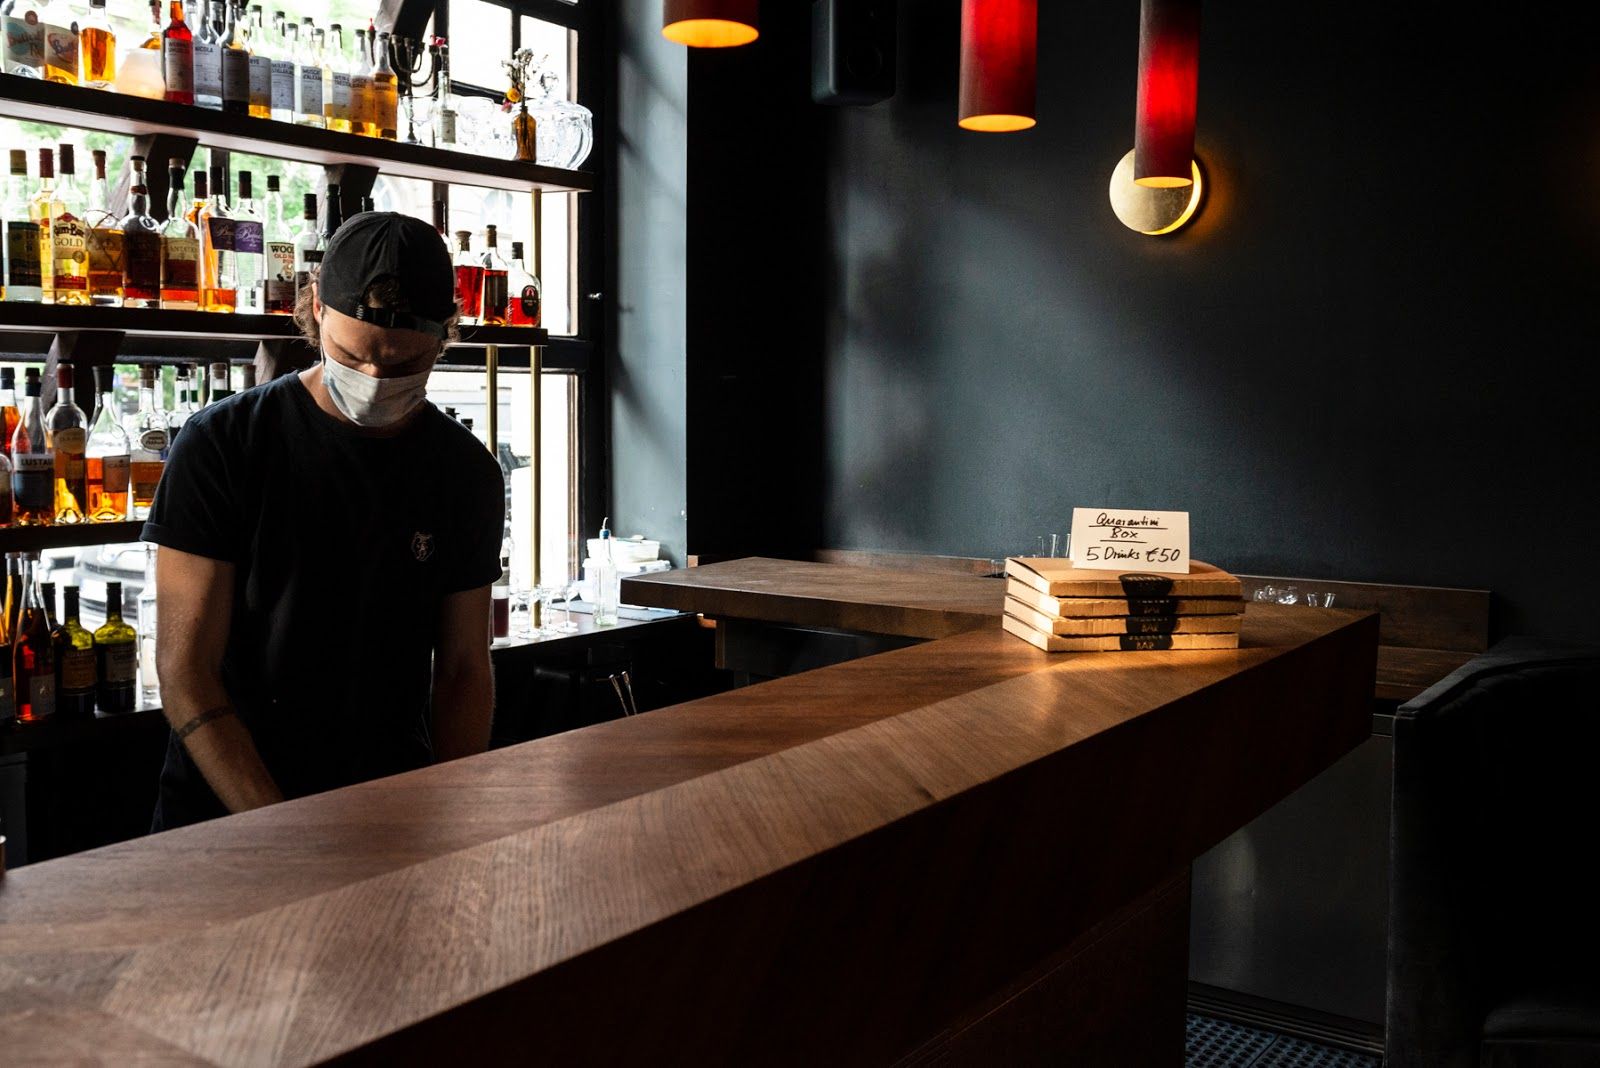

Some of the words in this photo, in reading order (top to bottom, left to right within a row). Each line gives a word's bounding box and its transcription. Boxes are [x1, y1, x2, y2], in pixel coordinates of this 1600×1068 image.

[54, 238, 83, 247] GOLD
[270, 245, 294, 254] WOO
[1096, 512, 1160, 527] Quarantini
[1109, 527, 1138, 539] Box
[1086, 546, 1102, 561] 5
[1104, 546, 1140, 560] Drinks
[1146, 547, 1181, 563] €50
